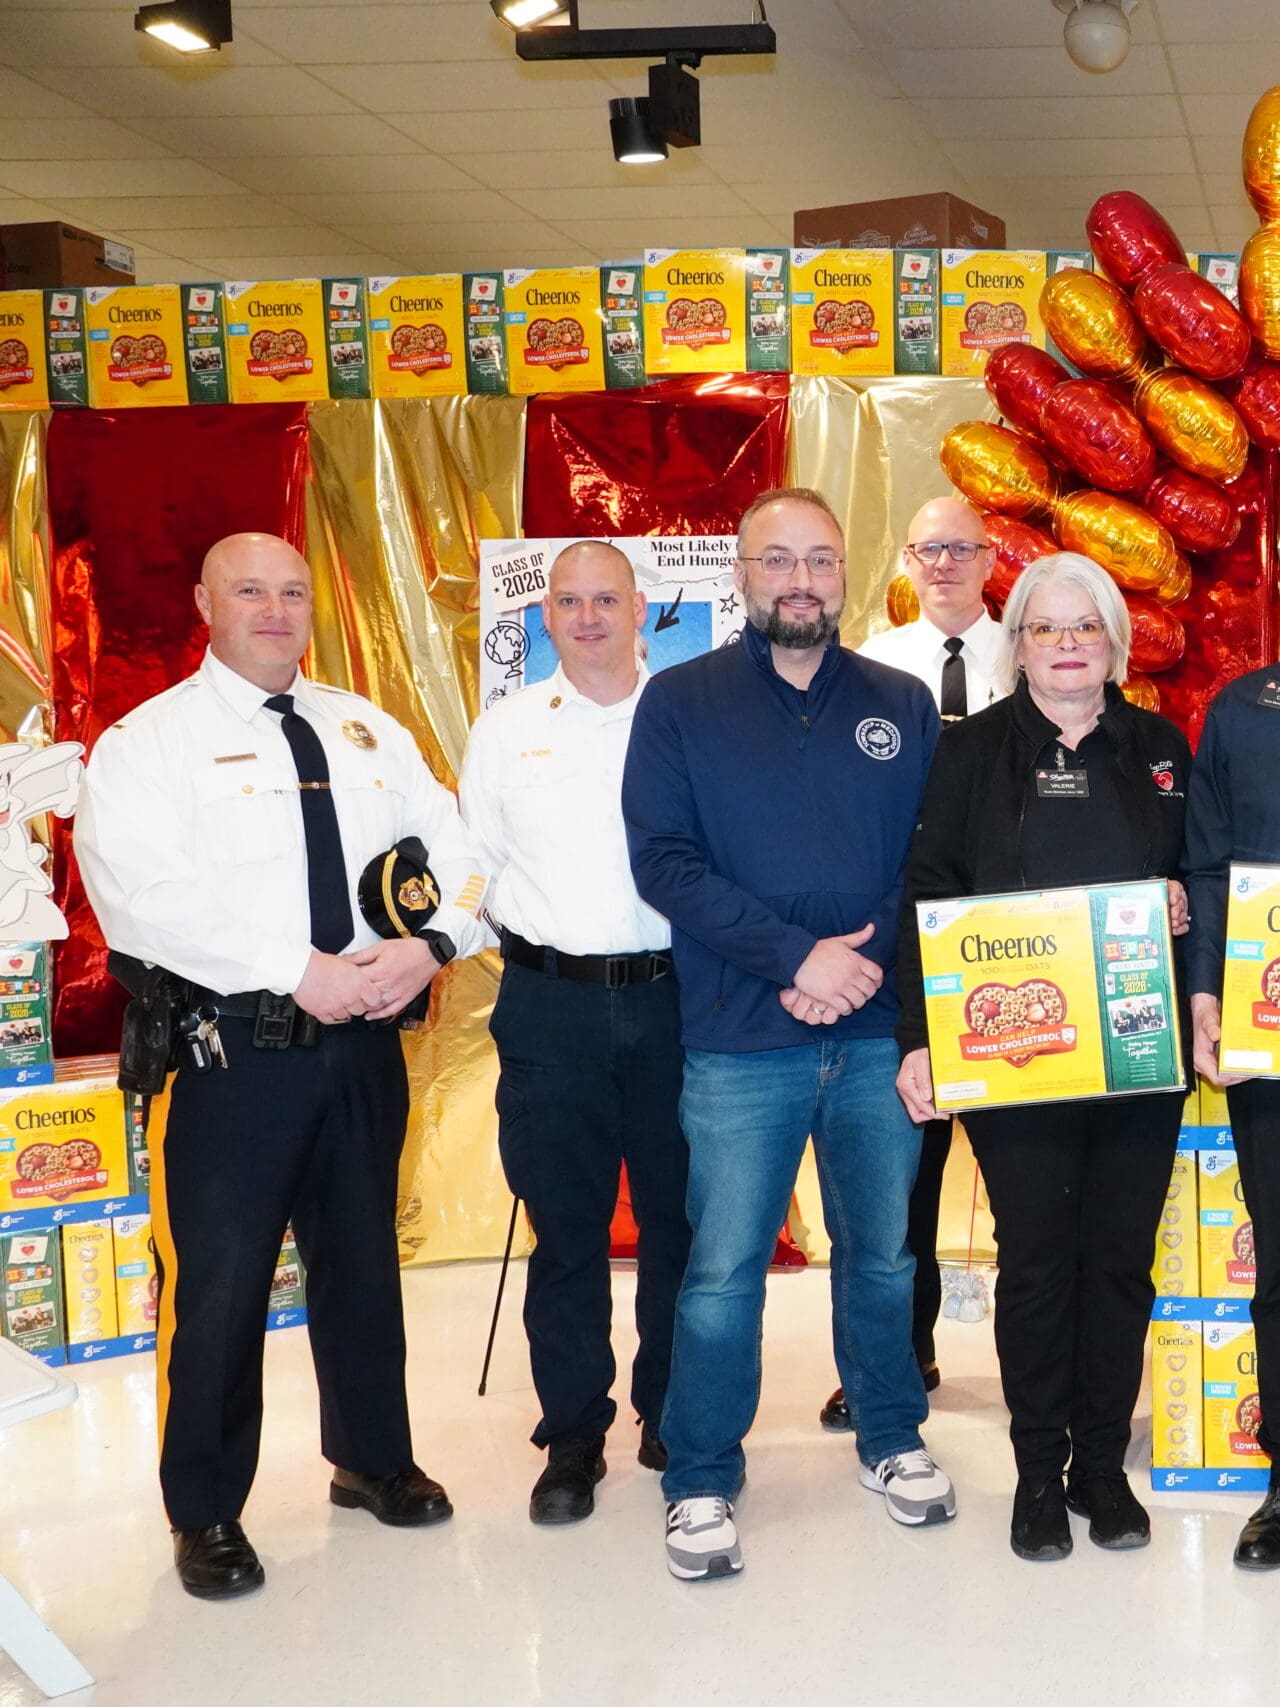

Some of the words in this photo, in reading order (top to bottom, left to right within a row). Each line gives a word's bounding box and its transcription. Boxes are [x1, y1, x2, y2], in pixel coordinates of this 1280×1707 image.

[667, 268, 724, 286] Cheerios
[814, 269, 872, 288] Cheerios
[965, 271, 1024, 289] Cheerios
[391, 296, 443, 312] Cheerios
[526, 288, 580, 306] Cheerios
[109, 306, 162, 323] Cheerios
[248, 300, 303, 317] Cheerios
[0, 312, 24, 326] erios
[650, 540, 683, 553] Most
[688, 539, 732, 555] Likely
[491, 557, 528, 578] CLASS
[527, 552, 545, 569] OF
[657, 555, 685, 567] End
[689, 554, 735, 569] Hunge
[502, 568, 546, 598] 2026
[961, 934, 1057, 963] Cheerios
[1026, 963, 1050, 971] OATS
[1124, 981, 1146, 994] 2026
[967, 1042, 998, 1053] LOWER
[1000, 1033, 1060, 1049] CHOLESTEROL
[1001, 1034, 1017, 1042] CAN
[1020, 1029, 1036, 1039] HELP
[15, 1107, 96, 1130] Cheerios
[17, 1186, 43, 1194] LOWER
[44, 1175, 95, 1190] CHOLESTEROL
